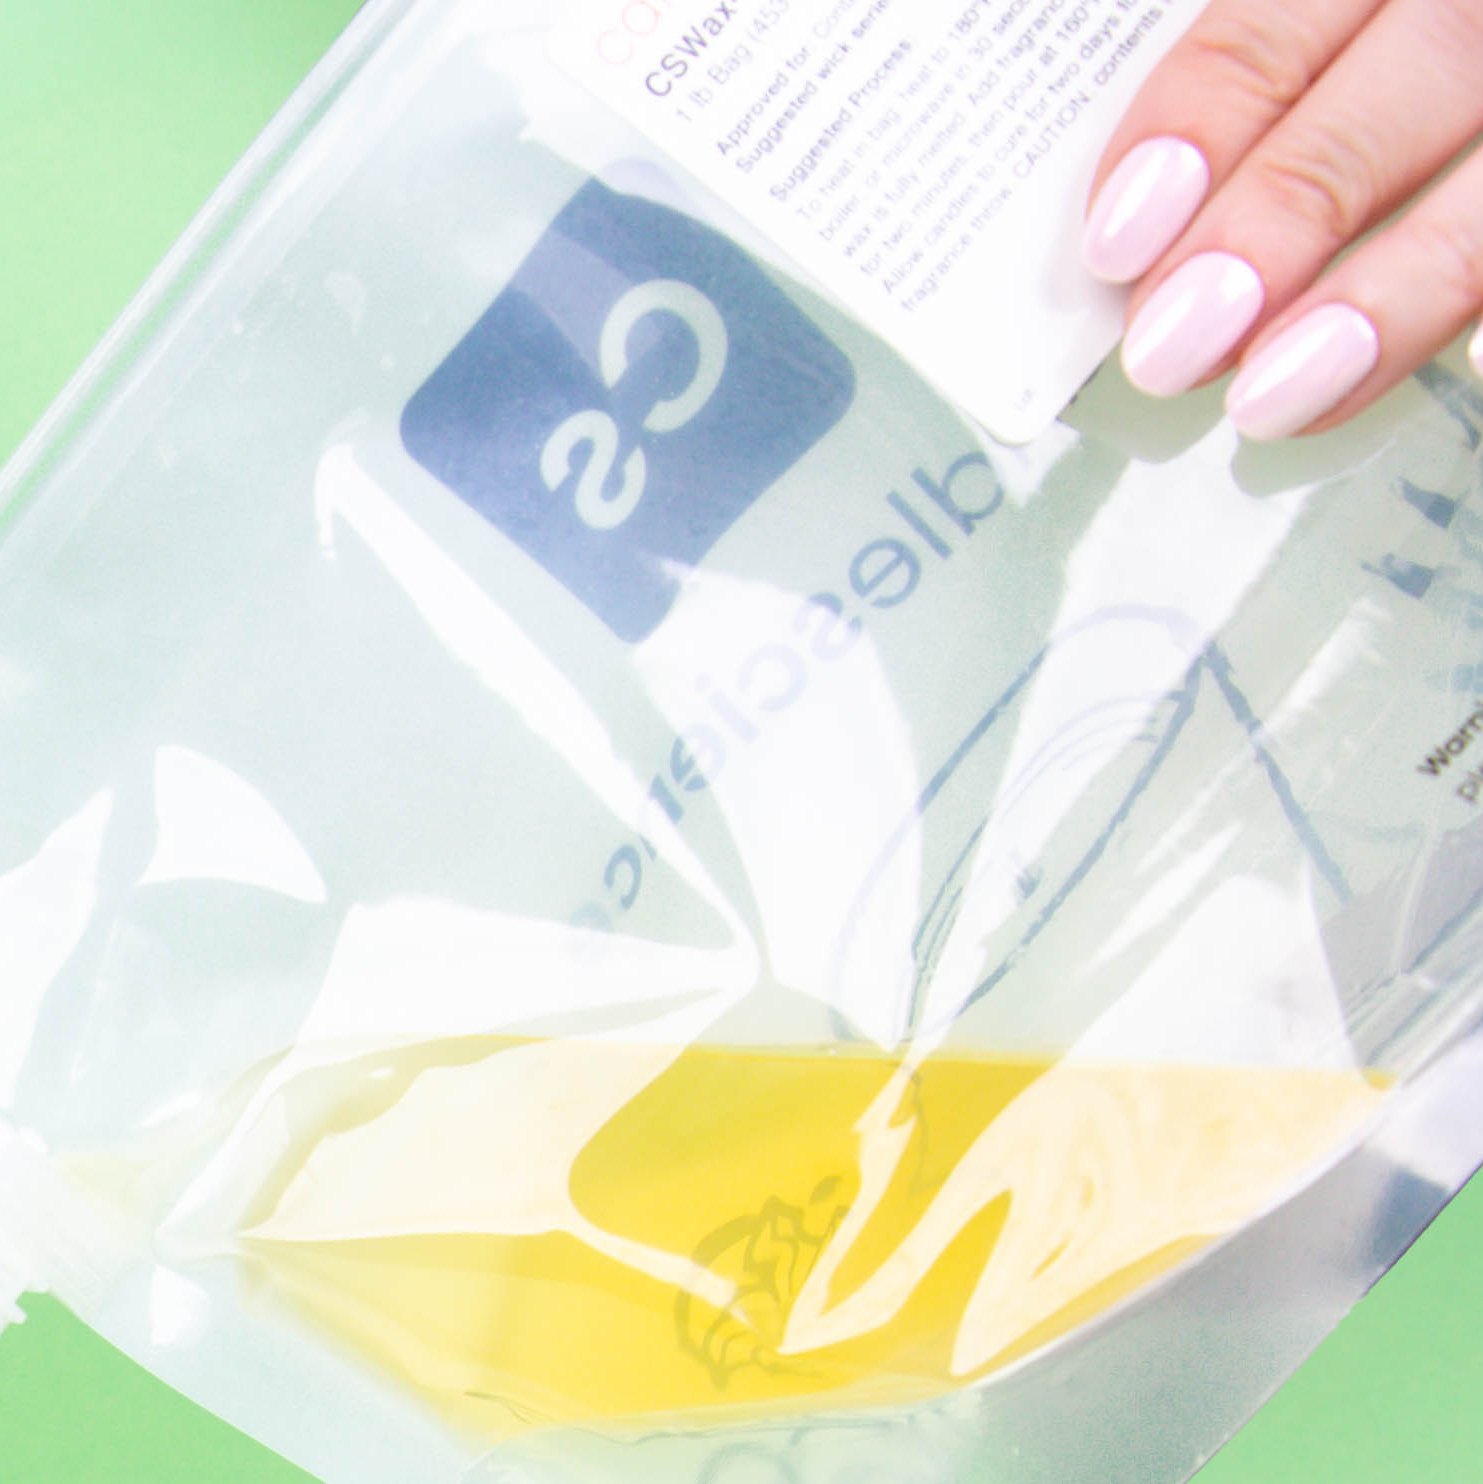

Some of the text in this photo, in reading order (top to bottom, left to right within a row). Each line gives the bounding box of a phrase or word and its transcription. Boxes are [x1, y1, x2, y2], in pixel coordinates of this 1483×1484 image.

[645, 0, 737, 97] CSWax
[706, 43, 754, 86] Bag
[715, 70, 790, 157] Approved
[735, 80, 818, 174] Suggested
[815, 40, 852, 80] wick
[880, 80, 958, 168] microwave
[966, 35, 995, 64] 30
[769, 107, 853, 202] Suggested
[817, 158, 857, 198] heat
[895, 62, 935, 104] heat
[928, 45, 950, 66] to
[857, 248, 886, 278] for
[881, 221, 913, 251] two
[967, 108, 1005, 149] then
[1001, 67, 1039, 112] pour
[1036, 43, 1060, 68] at
[878, 248, 925, 296] Allow
[923, 183, 981, 248] candles
[974, 163, 998, 183] to
[993, 120, 1031, 162] cure
[1023, 95, 1050, 123] for
[1046, 61, 1081, 96] two
[1078, 13, 1122, 62] days
[900, 232, 973, 312] fragrance
[1092, 6, 1167, 87] contents
[842, 224, 873, 259] wax
[882, 168, 921, 208] fully
